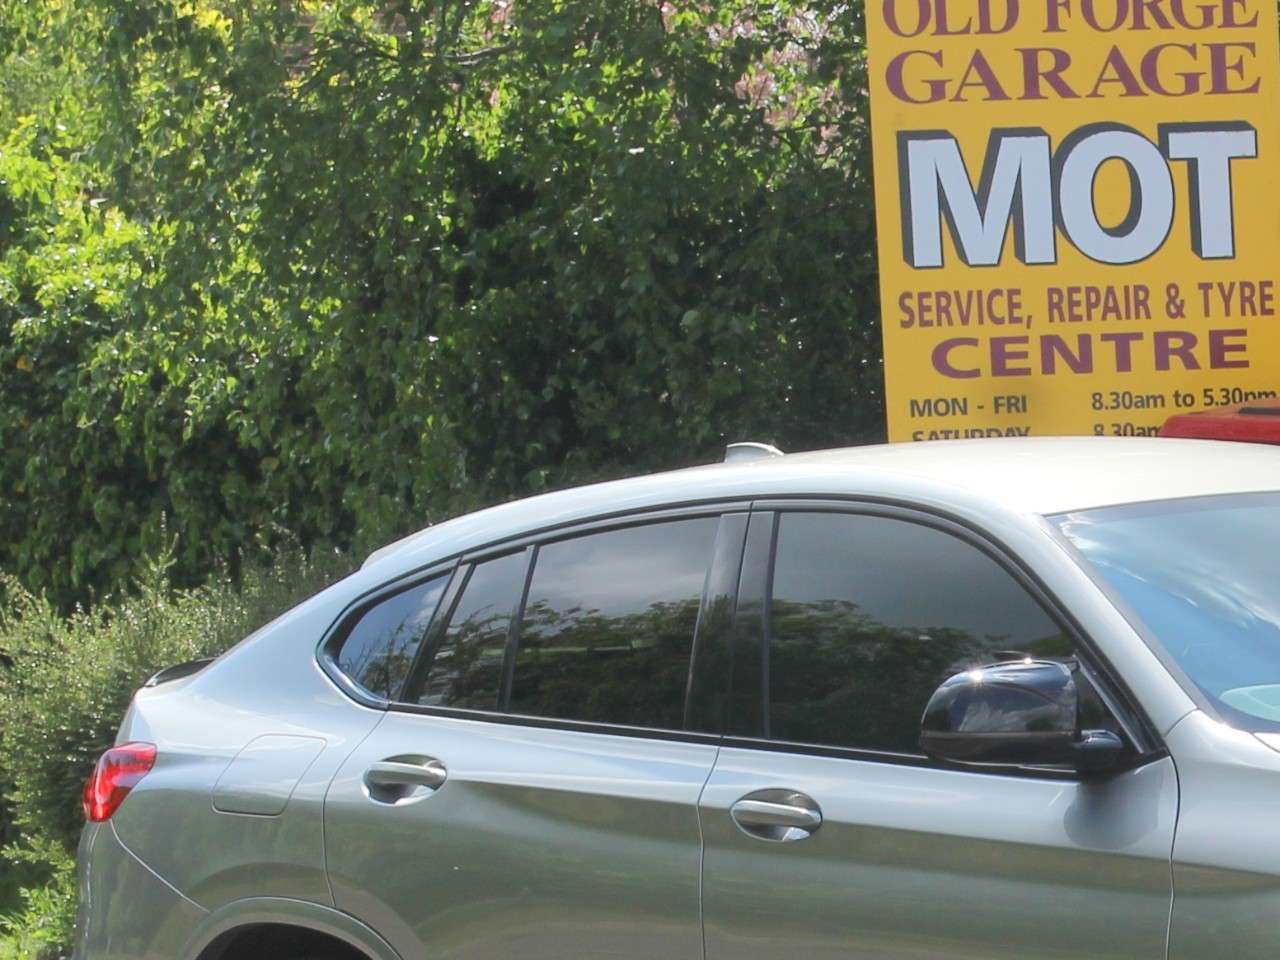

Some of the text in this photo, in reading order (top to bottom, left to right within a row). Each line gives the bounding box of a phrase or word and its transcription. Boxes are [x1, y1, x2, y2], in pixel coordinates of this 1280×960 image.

[882, 0, 1260, 38] OLD FORGE
[884, 42, 1262, 105] GARAGE
[897, 121, 1258, 269] MOT
[899, 281, 1275, 329] SERVICE, REPAIR & TYRE
[931, 329, 1250, 380] CENTRE
[910, 398, 968, 418] MON
[993, 395, 1028, 415] FRI
[1091, 391, 1165, 411] 8.30am
[1173, 390, 1195, 408] to
